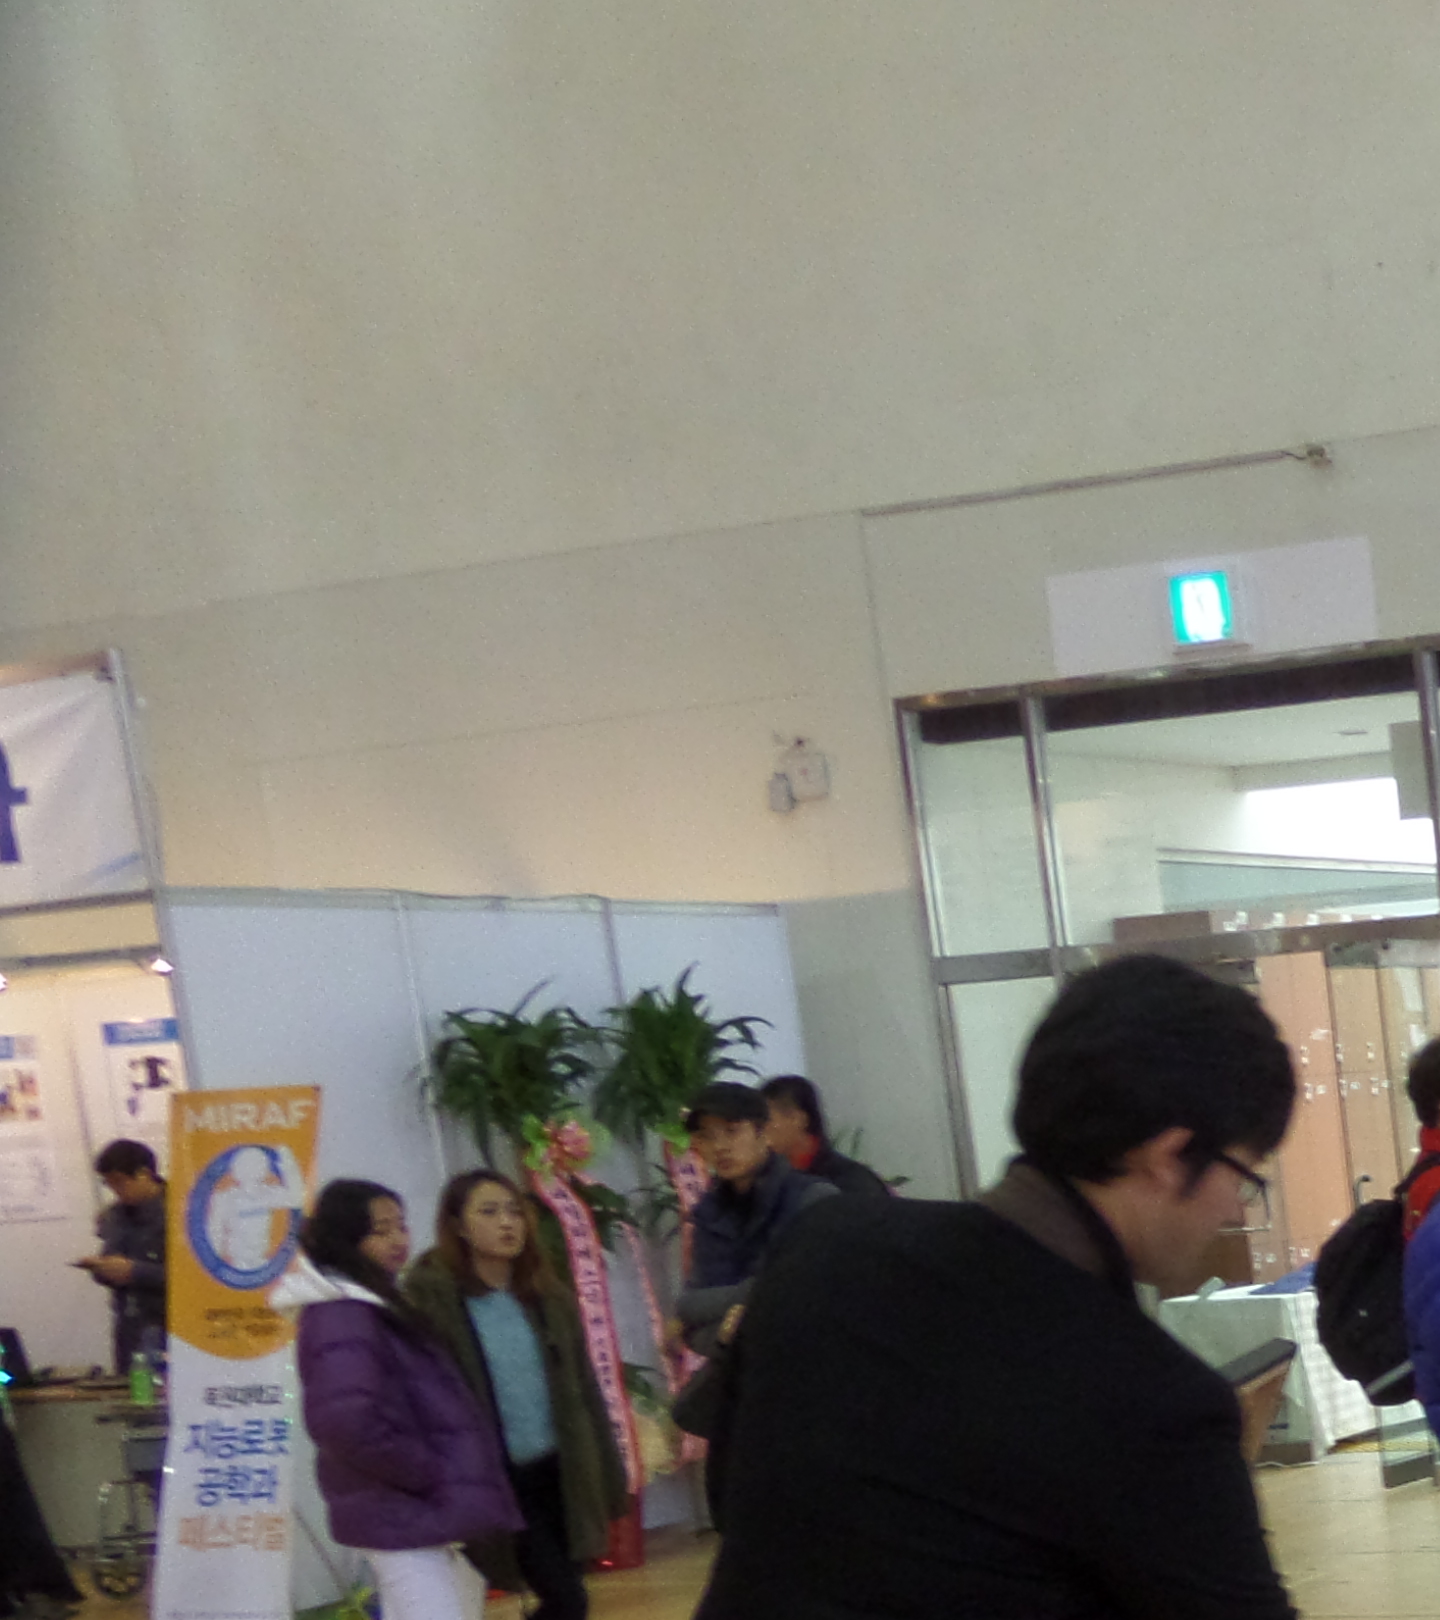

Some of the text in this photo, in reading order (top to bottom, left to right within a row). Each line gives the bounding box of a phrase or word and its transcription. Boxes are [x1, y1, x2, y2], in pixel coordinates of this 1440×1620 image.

[185, 1098, 313, 1133] MIRAF
[183, 1419, 291, 1460] 지능로봇
[195, 1464, 279, 1508] 공학과
[179, 1512, 286, 1552] 페스티벌
